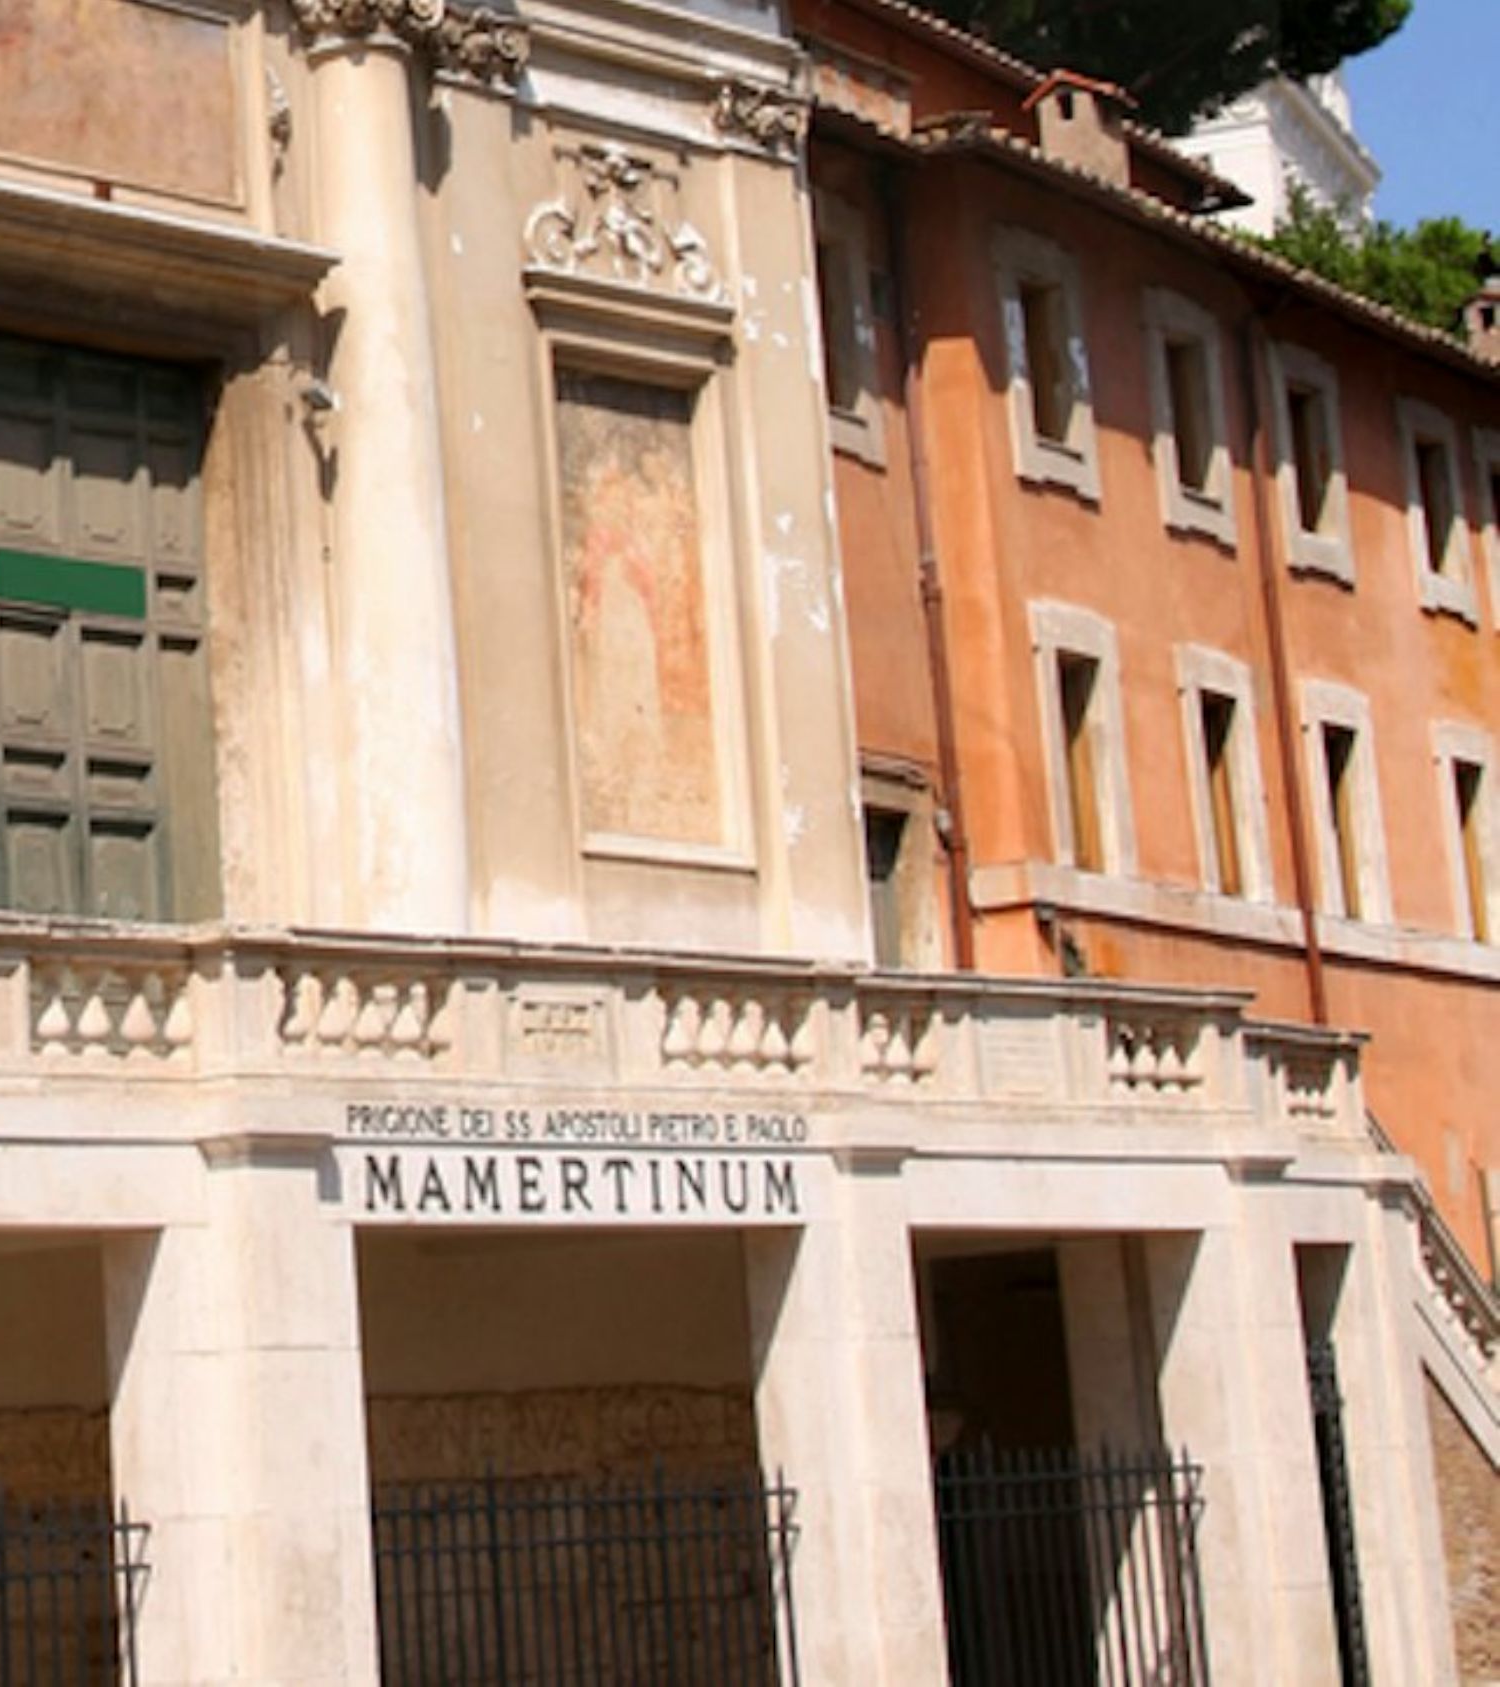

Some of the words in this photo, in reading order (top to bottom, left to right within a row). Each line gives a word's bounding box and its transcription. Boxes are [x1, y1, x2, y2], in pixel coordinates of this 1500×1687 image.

[347, 1104, 449, 1136] PRIGIONE
[461, 1109, 493, 1137] DEI
[544, 1110, 641, 1139] APOSTOLI
[648, 1113, 719, 1142] PIETRO
[724, 1113, 738, 1143] E
[746, 1114, 807, 1143] PAOLO
[364, 1153, 799, 1214] MAMERTINUM
